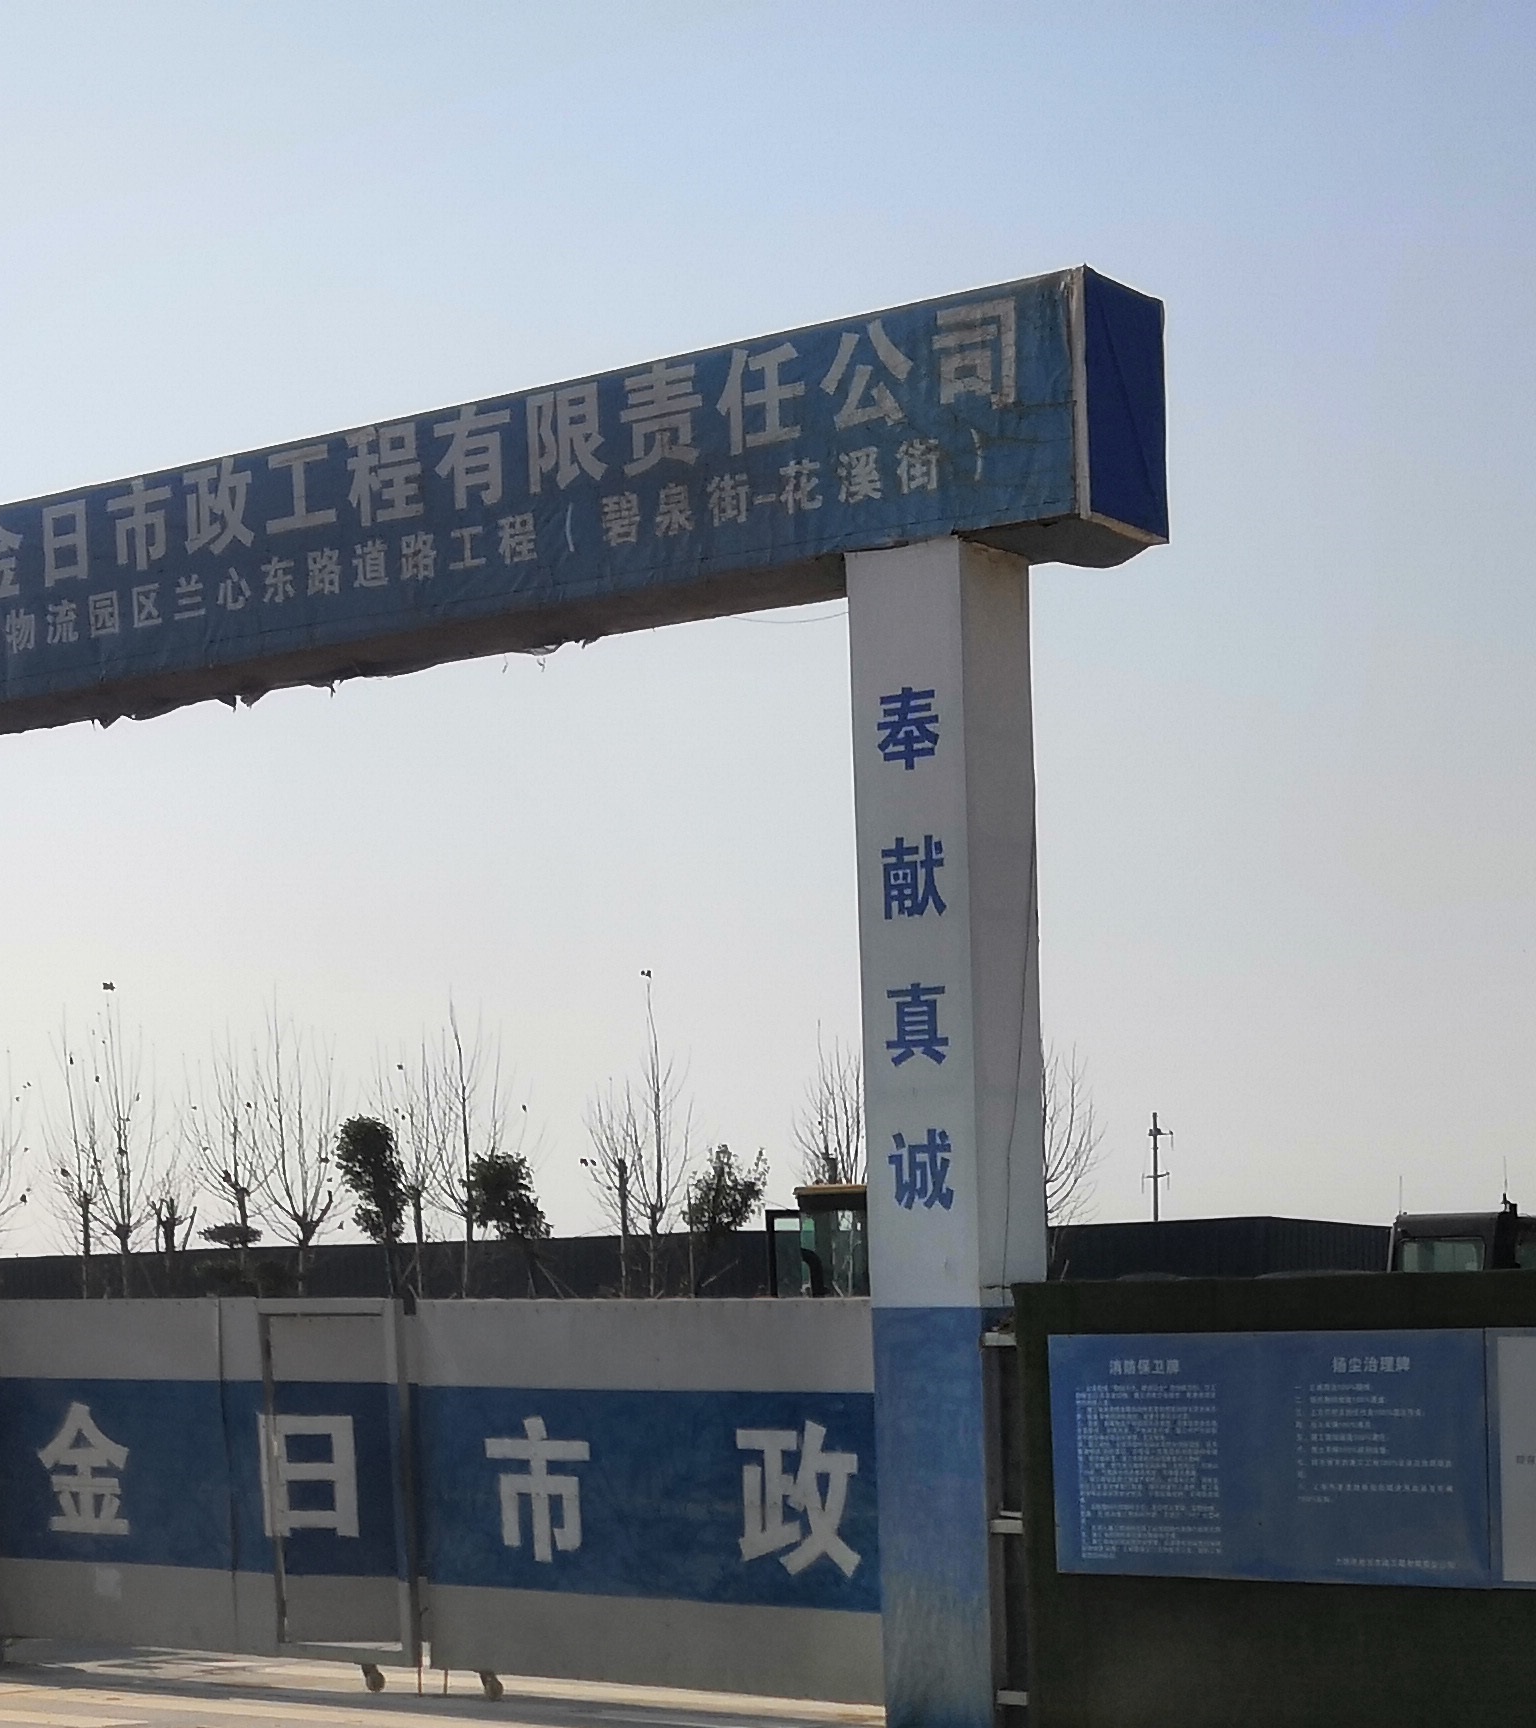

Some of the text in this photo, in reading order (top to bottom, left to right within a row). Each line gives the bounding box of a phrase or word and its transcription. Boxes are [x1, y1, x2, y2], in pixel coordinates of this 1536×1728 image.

[876, 686, 955, 1211] 奉献真诚
[36, 1401, 862, 1580] 金日市政
